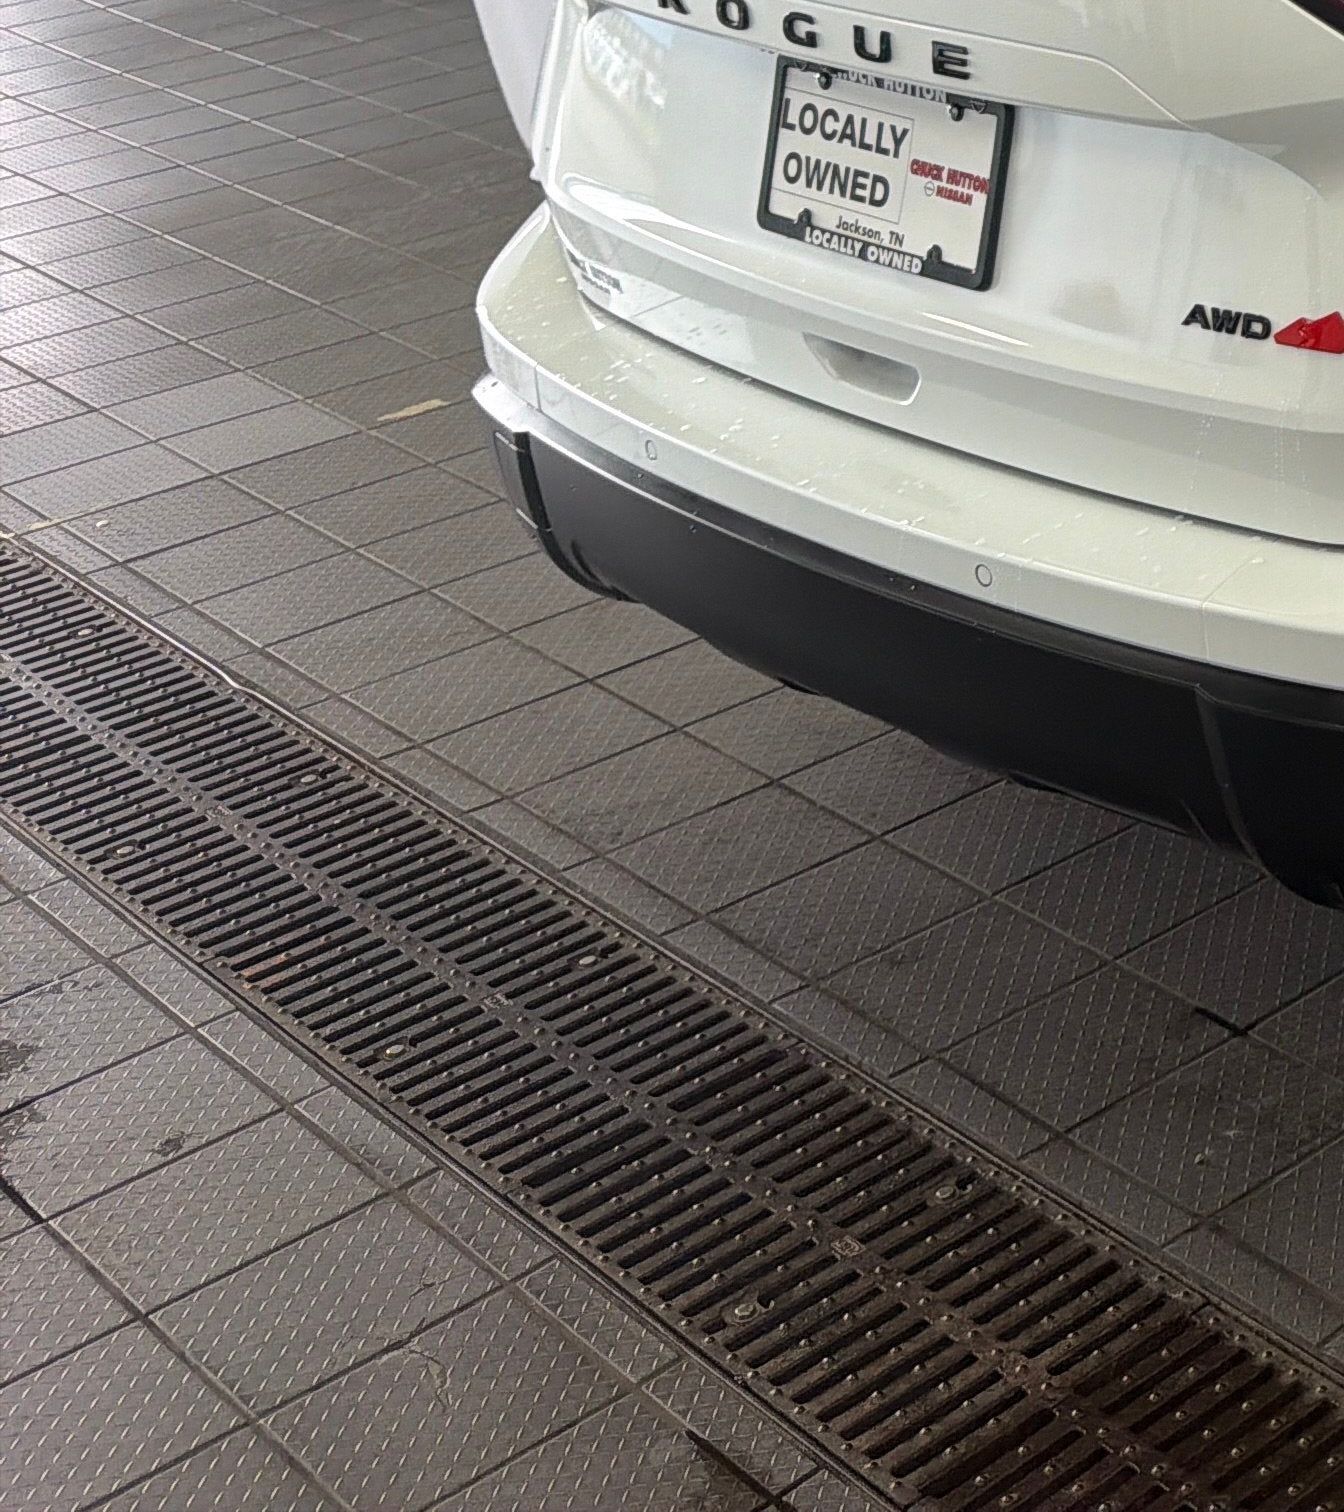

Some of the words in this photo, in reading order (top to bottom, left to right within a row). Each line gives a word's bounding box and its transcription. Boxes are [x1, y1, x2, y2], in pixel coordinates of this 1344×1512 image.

[781, 97, 910, 159] LOCALLY
[783, 152, 890, 208] OWNED
[910, 158, 946, 182] CHUCK
[935, 185, 974, 206] NISSAN
[804, 226, 864, 257] LOCALLY
[867, 244, 922, 274] OWNED
[835, 215, 884, 246] Jackson,
[888, 230, 905, 248] TN
[1181, 303, 1272, 340] AWD
